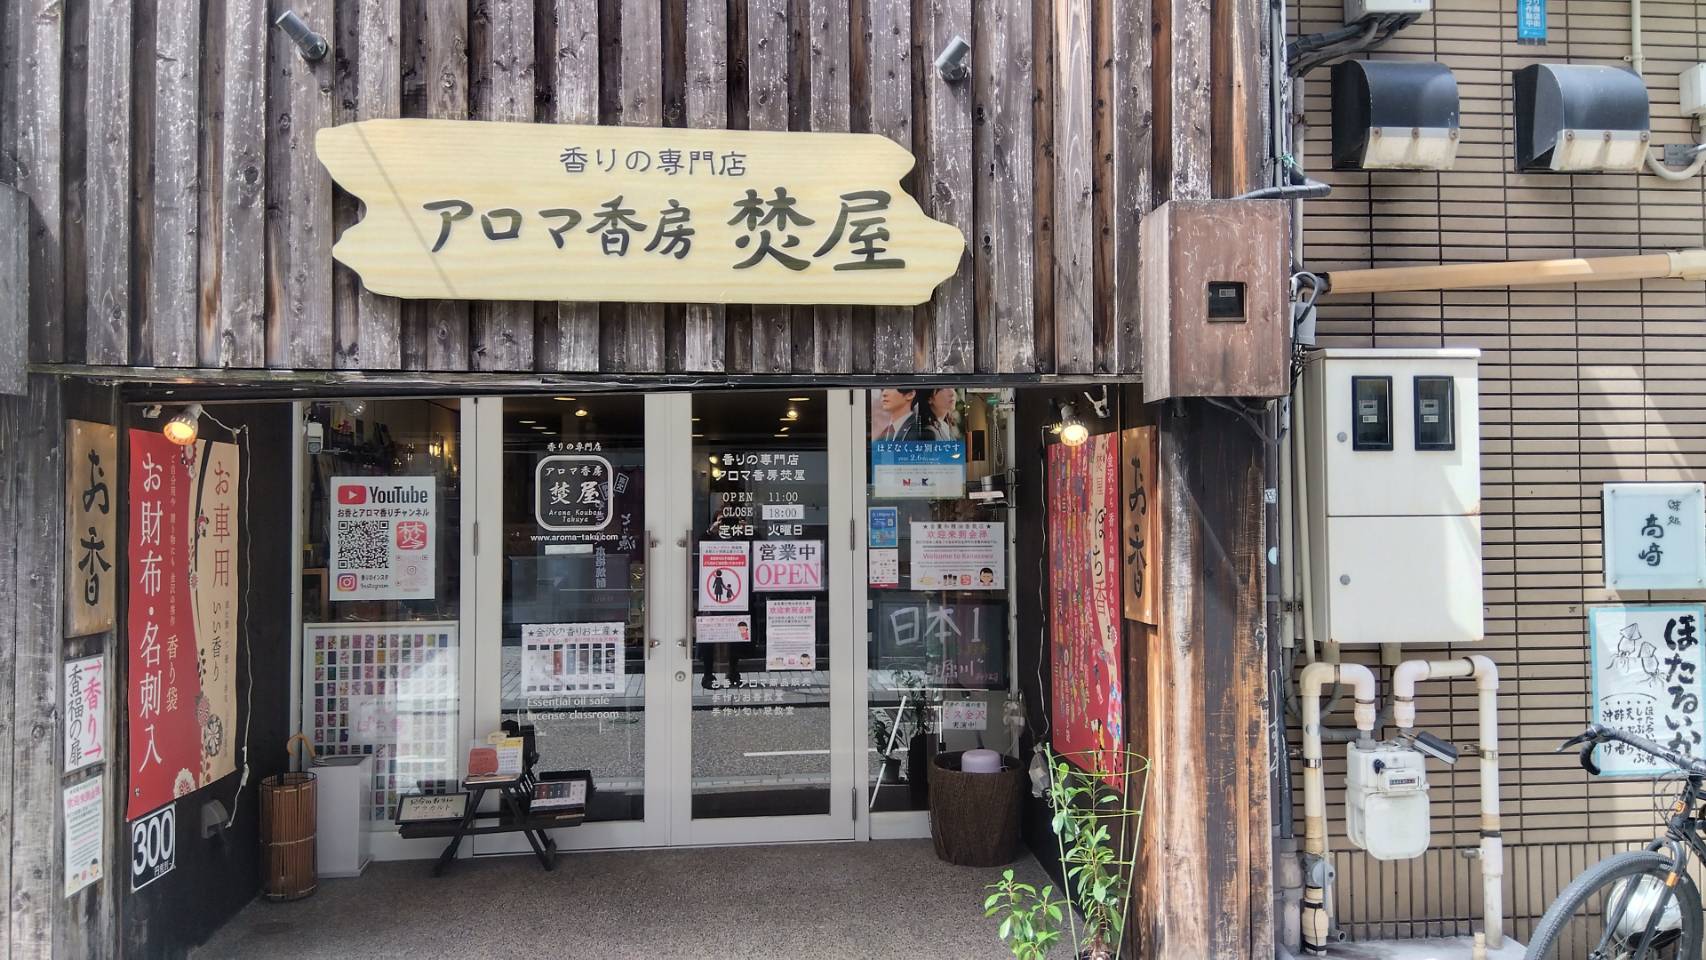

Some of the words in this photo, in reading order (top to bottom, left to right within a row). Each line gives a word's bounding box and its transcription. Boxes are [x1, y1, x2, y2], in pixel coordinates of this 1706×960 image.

[560, 146, 748, 177] 香りの専門店
[423, 195, 697, 260] アロマ香房
[727, 186, 906, 271] 焚屋
[547, 442, 602, 452] 香りの専門店
[877, 443, 961, 453] ほどなく、お別れです
[722, 453, 799, 466] 香りの専門店
[545, 465, 603, 476] アロマ香房
[716, 469, 806, 481] アロマ香房焚屋
[369, 486, 429, 504] YouTube
[548, 481, 601, 505] 焚屋
[722, 492, 754, 502] OPEN
[769, 492, 798, 501] 11:00
[337, 508, 430, 518] お香とアロマ香りチャンネル
[722, 507, 754, 517] CLOSE
[769, 509, 798, 519] 18:00
[79, 447, 112, 607] お香
[212, 461, 231, 588] お車用
[719, 524, 754, 536] 定休日
[768, 524, 803, 536] 火曜日
[1128, 455, 1148, 599] お香
[530, 533, 619, 541] www.aroma-taku.com
[759, 543, 816, 561] 営業中
[923, 552, 952, 560] Welcome
[755, 563, 820, 586] OPEN
[140, 452, 164, 773] お財布・名刺入
[536, 626, 611, 638] 金沢の香りお土産
[211, 601, 222, 682] いい香り
[167, 634, 179, 712] 香り袋
[1663, 614, 1702, 757] ほたるいか
[83, 676, 102, 745] 香り
[527, 696, 571, 707] Essential
[574, 696, 586, 705] oil
[589, 696, 610, 705] sale
[569, 710, 619, 720] classroom
[1602, 708, 1614, 756] 沖け
[133, 809, 174, 876] 300
